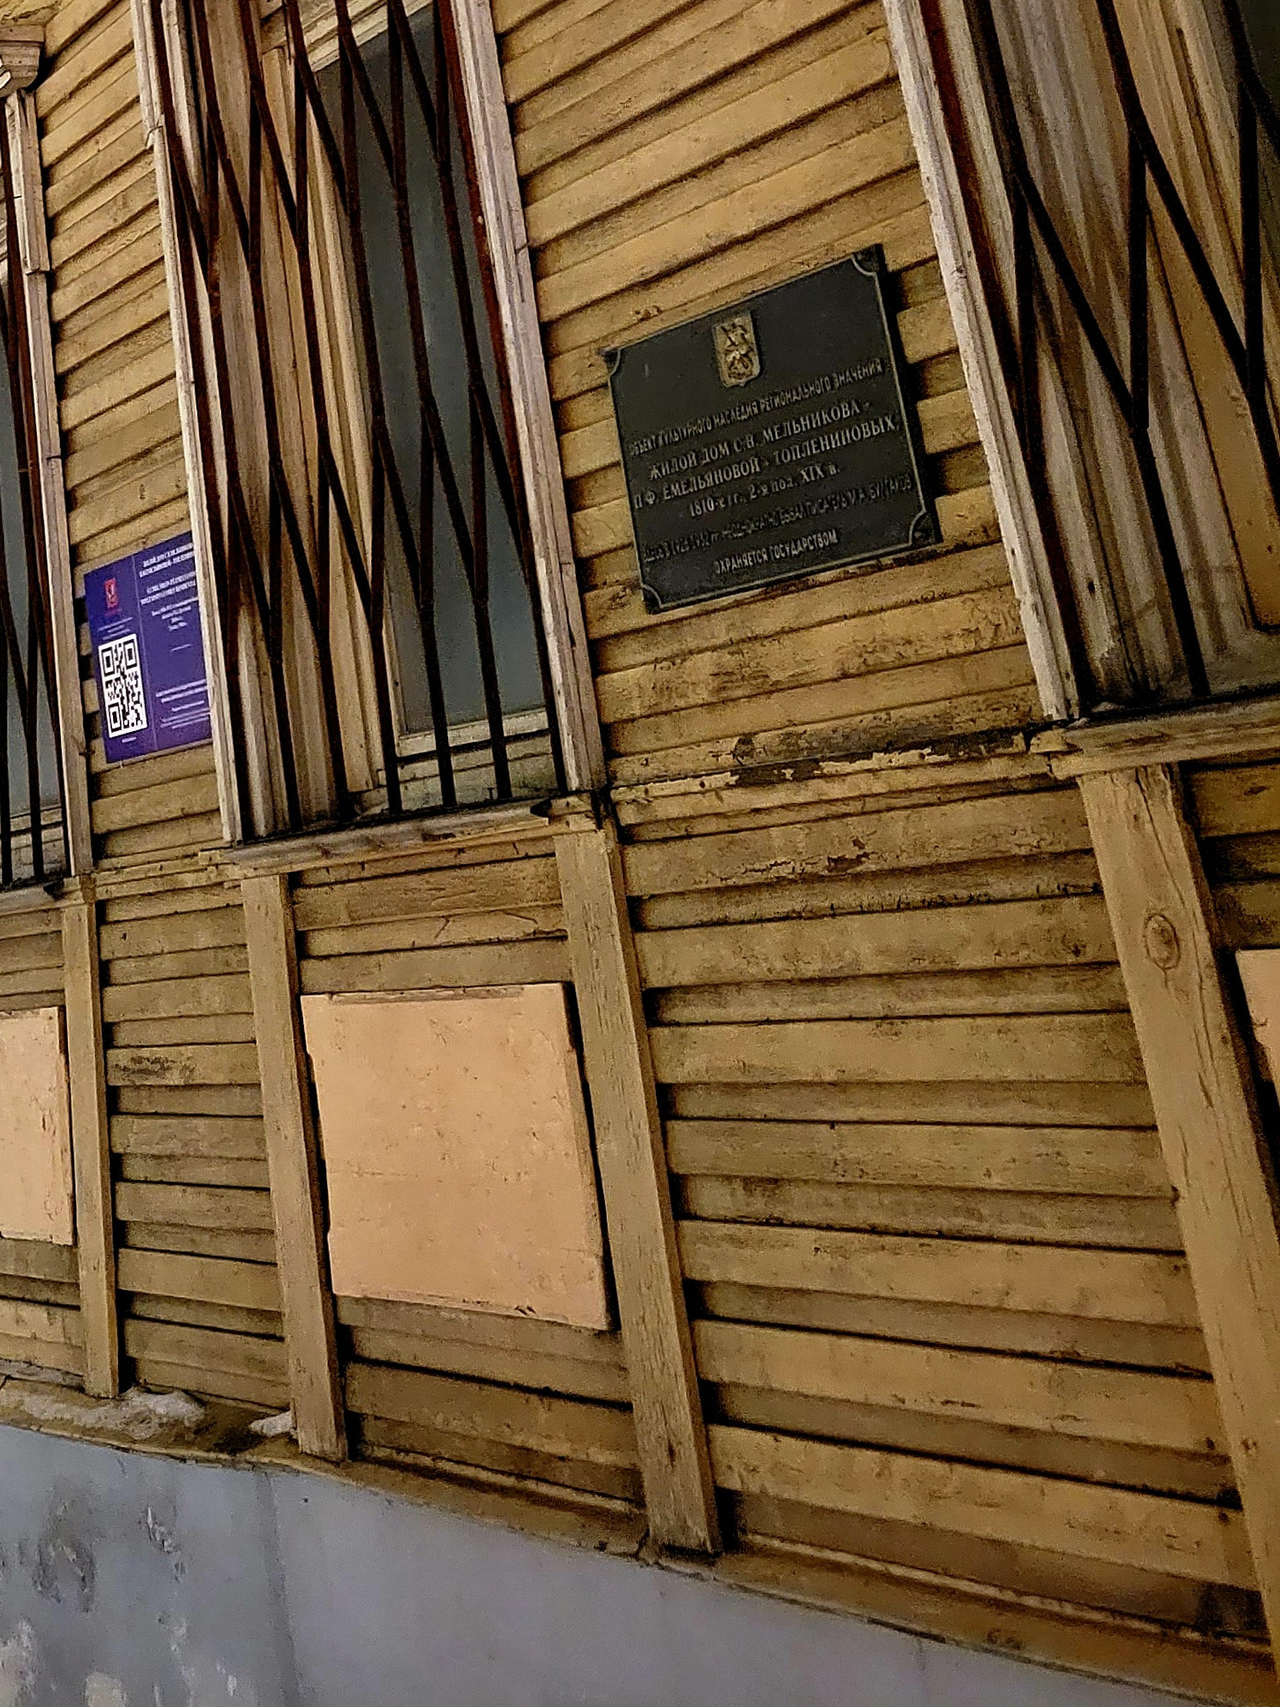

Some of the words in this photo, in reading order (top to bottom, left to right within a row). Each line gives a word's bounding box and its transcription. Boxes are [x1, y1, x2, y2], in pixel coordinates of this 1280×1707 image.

[713, 400, 759, 427] НАСЛЕДИЯ
[760, 375, 832, 412] РЕГИОНАЛЬНОГО
[833, 357, 883, 387] ЗНАЧЕНИЯ
[650, 451, 698, 481] ЖИЛОЙ
[701, 441, 730, 465] ДОМ
[762, 399, 860, 443] МЕЛЬНИКОВА
[663, 456, 761, 500] ЕМЕЛЬЯНОВОЙ
[715, 547, 768, 574] ОХРАНЯЕТСЯ
[769, 529, 839, 561] ГОСУДАРСТВОМ
